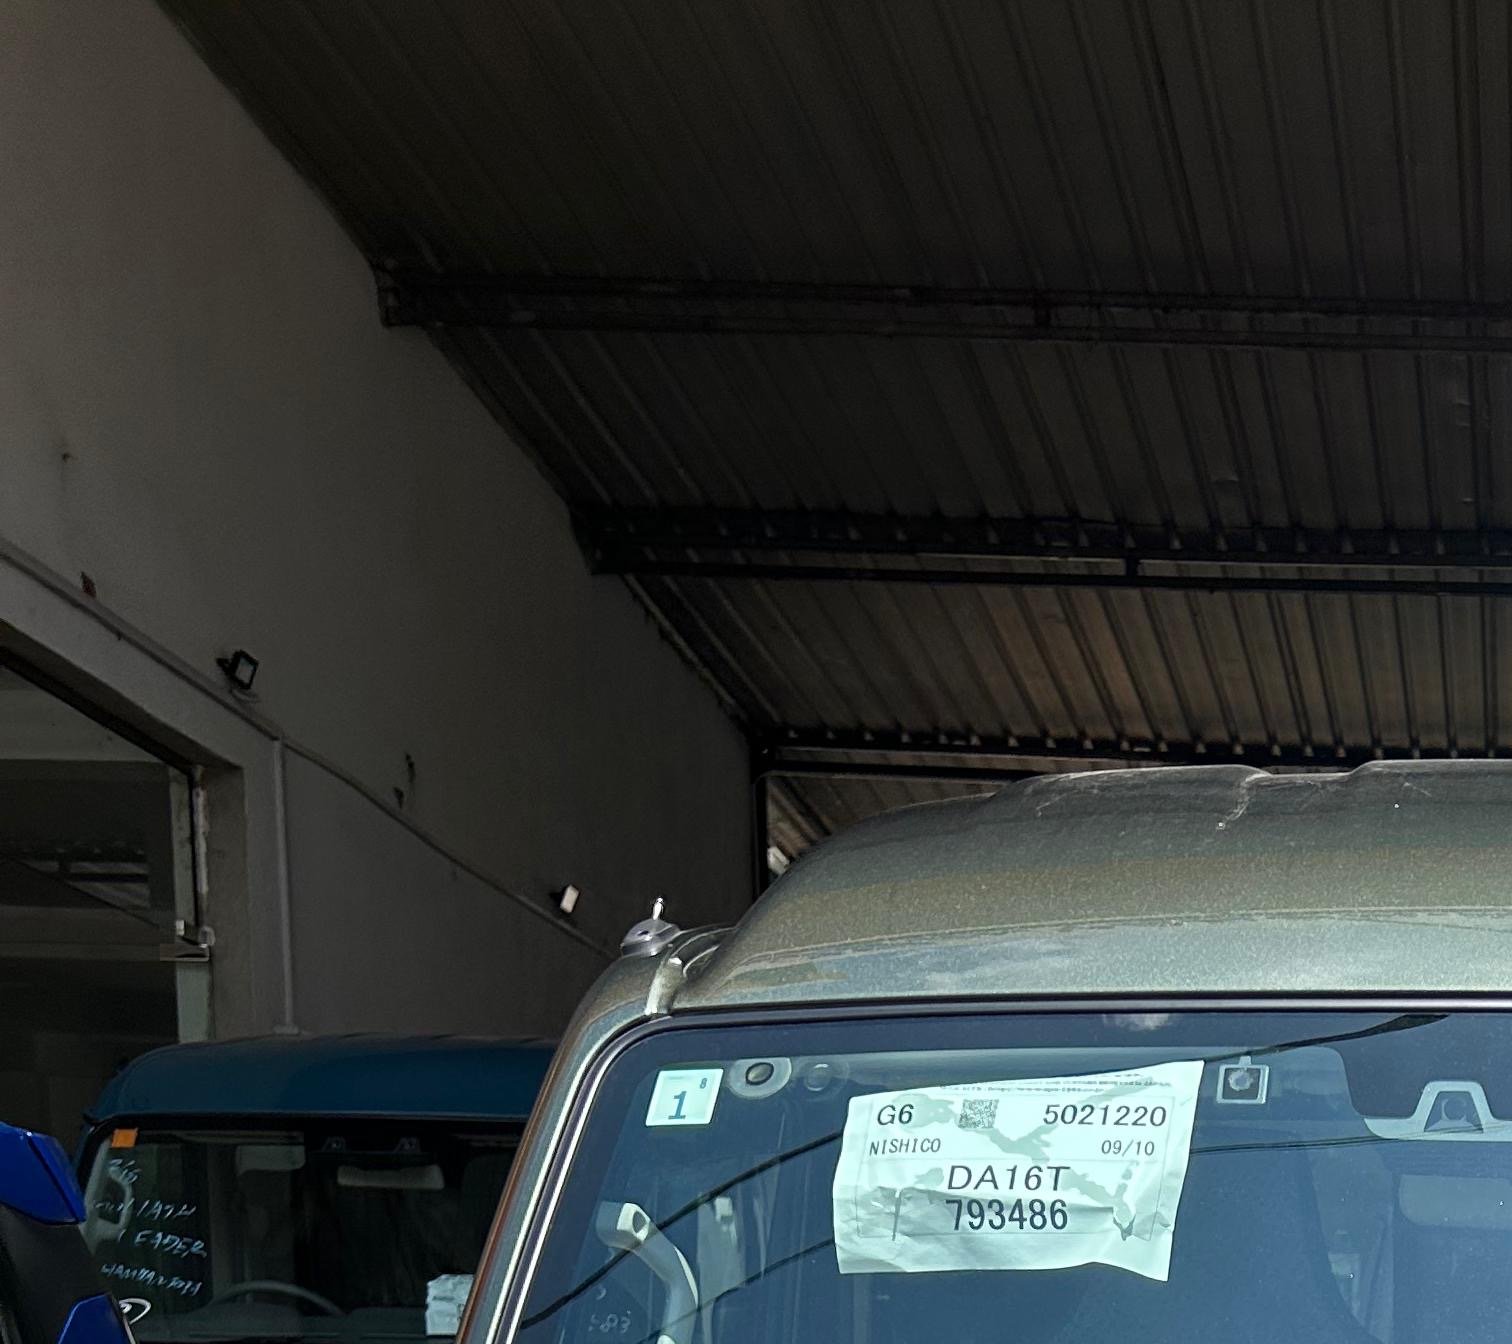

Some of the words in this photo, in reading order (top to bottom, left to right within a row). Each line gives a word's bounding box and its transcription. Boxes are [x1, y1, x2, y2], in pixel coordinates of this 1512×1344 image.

[667, 1090, 687, 1120] 1
[877, 1103, 915, 1126] G6
[1042, 1104, 1167, 1127] 5021220
[869, 1137, 942, 1156] NISHICO
[1100, 1139, 1155, 1157] 09/10
[947, 1164, 1072, 1191] DA16T
[945, 1199, 1069, 1231] 793486
